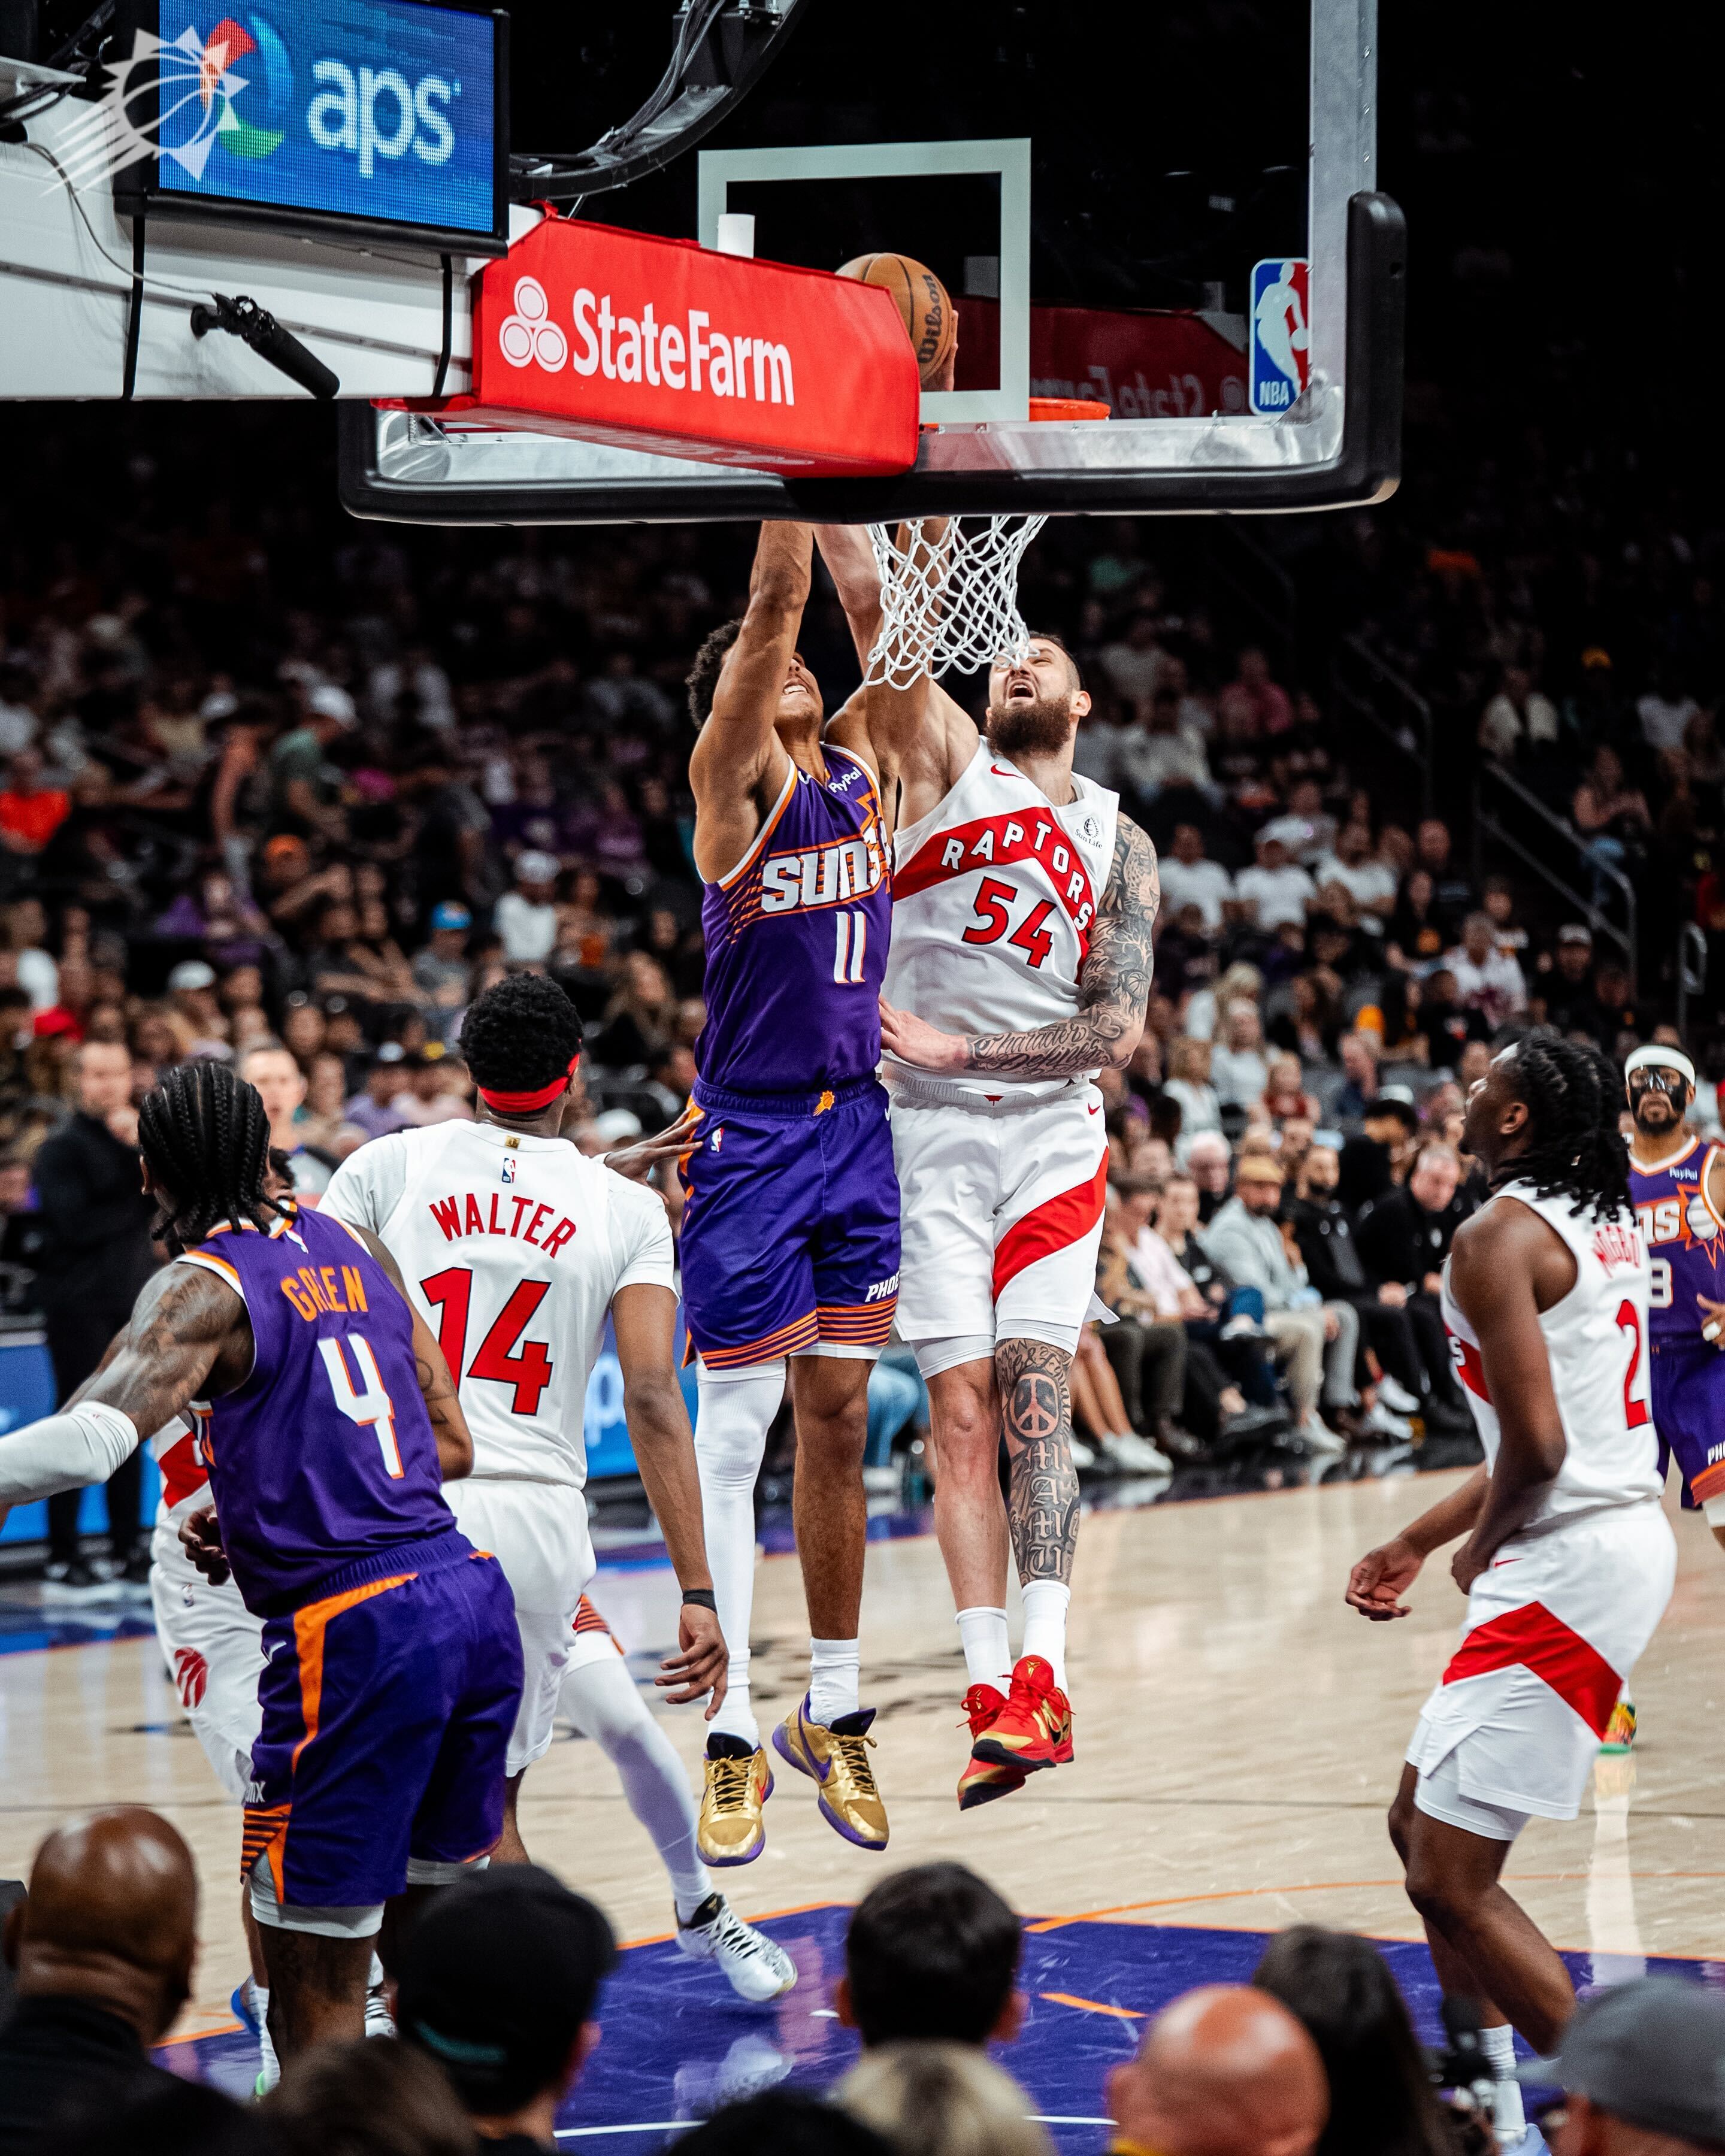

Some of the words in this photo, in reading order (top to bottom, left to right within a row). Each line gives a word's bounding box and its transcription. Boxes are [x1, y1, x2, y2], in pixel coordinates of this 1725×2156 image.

[308, 58, 455, 178] aps
[918, 274, 942, 364] Wilson
[1259, 381, 1290, 407] NBA
[940, 820, 1093, 931] RAPTORS
[1075, 828, 1087, 842] Sun
[1088, 838, 1103, 849] Life
[833, 911, 866, 983] 11
[961, 876, 1057, 969] 54
[1669, 1167, 1697, 1180] PayPal
[428, 1193, 577, 1259] WALTER
[280, 1265, 368, 1322] GREN
[420, 1267, 553, 1417] 14
[1615, 1298, 1651, 1430] 2
[317, 1333, 404, 1479] 4
